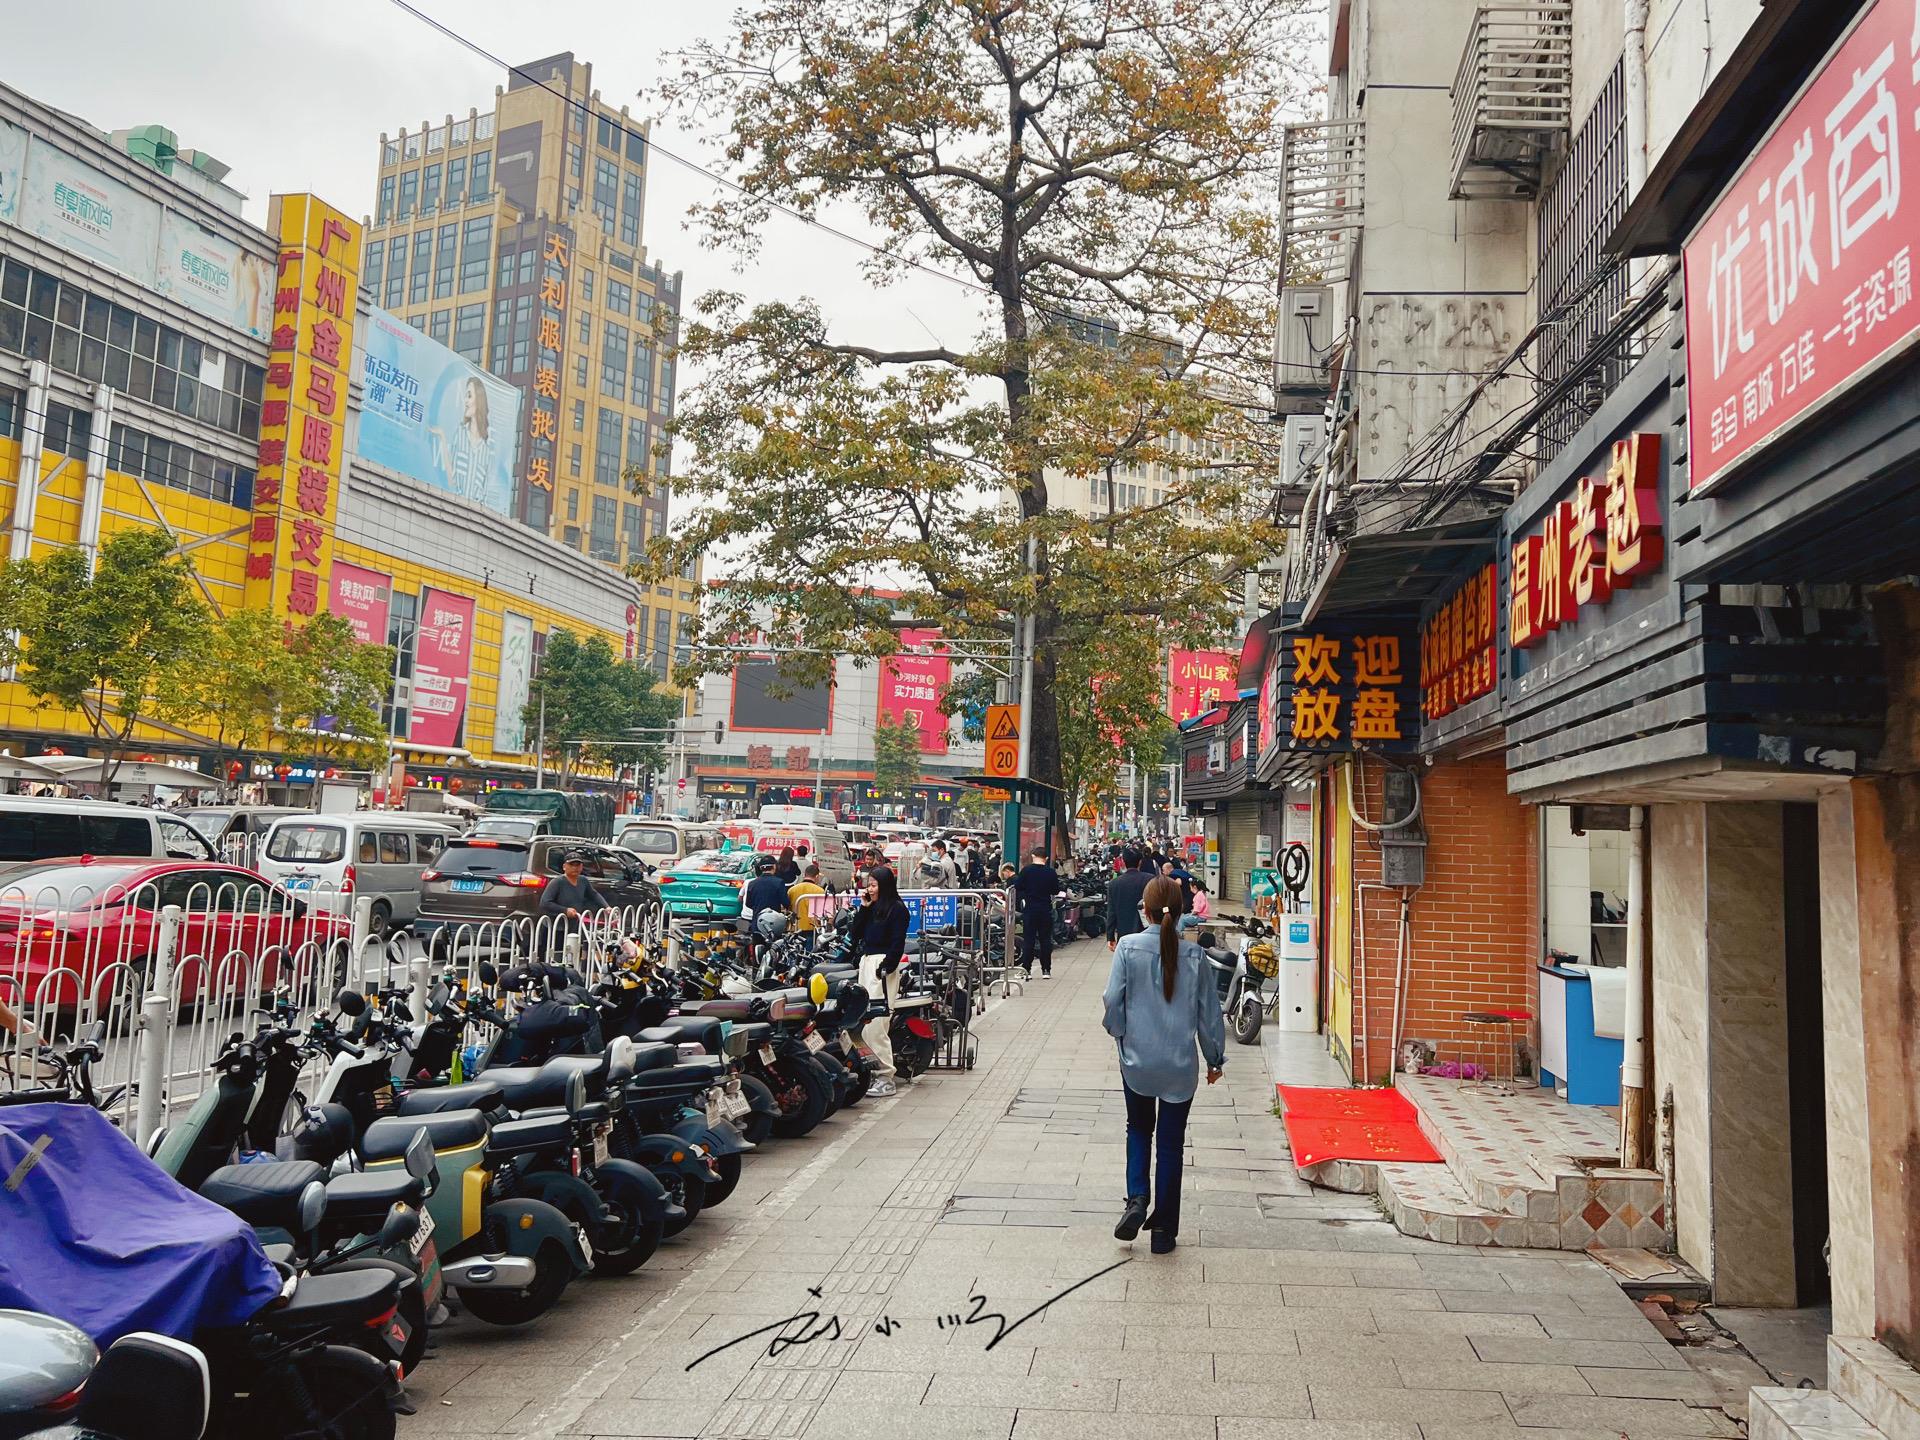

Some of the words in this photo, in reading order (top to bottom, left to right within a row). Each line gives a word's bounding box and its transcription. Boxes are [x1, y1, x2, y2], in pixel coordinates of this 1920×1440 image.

[54, 181, 113, 230] 春夏新风尚
[1707, 0, 1920, 381] 优诚商
[527, 232, 569, 492] 大利服装批发
[1779, 329, 1815, 399] 万佳
[1823, 245, 1912, 347] 一手资源
[246, 250, 304, 580] 广州金马服装交易城
[283, 218, 351, 646] 广州金马服装交易
[1510, 432, 1642, 648] 温州老赵
[894, 684, 935, 700] 实力质造
[1181, 662, 1230, 682] 小山家
[1293, 634, 1403, 687] 欢迎
[996, 751, 1013, 769] 20
[1293, 688, 1402, 740] 放盘
